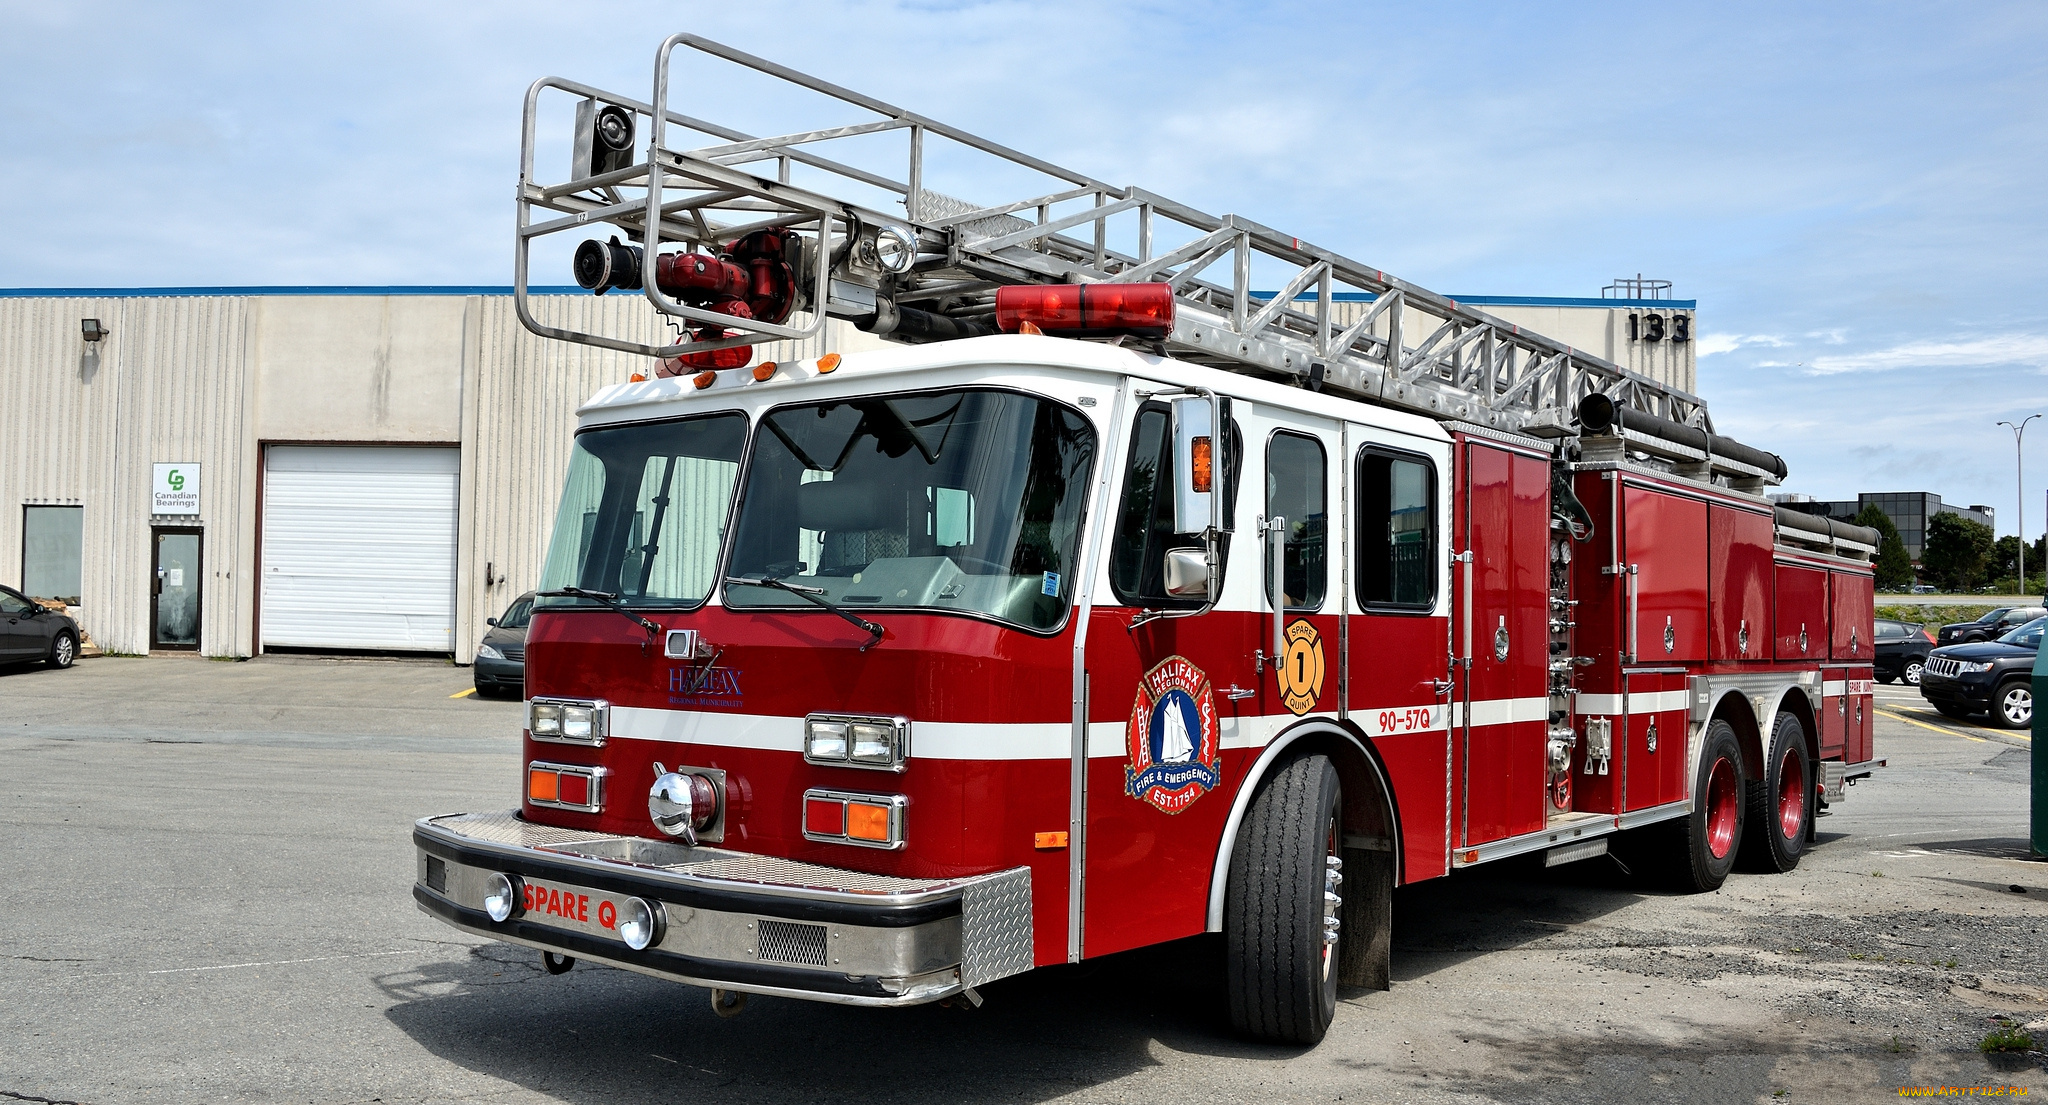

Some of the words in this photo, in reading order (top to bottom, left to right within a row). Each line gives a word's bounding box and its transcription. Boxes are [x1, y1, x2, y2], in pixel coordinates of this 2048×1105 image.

[1629, 314, 1689, 342] 133
[156, 499, 195, 508] Bearings
[1291, 625, 1313, 639] SPARE
[1152, 663, 1199, 687] HALIFAX
[1296, 652, 1304, 683] 1
[1155, 677, 1194, 696] REGIONAL
[1289, 698, 1311, 710] QUINT
[1379, 708, 1430, 732] 90-57Q
[1135, 772, 1155, 792] FIRE
[1156, 771, 1162, 781] &
[1164, 768, 1212, 784] EMERGENCY
[523, 884, 588, 922] SPARE
[598, 900, 616, 930] Q
